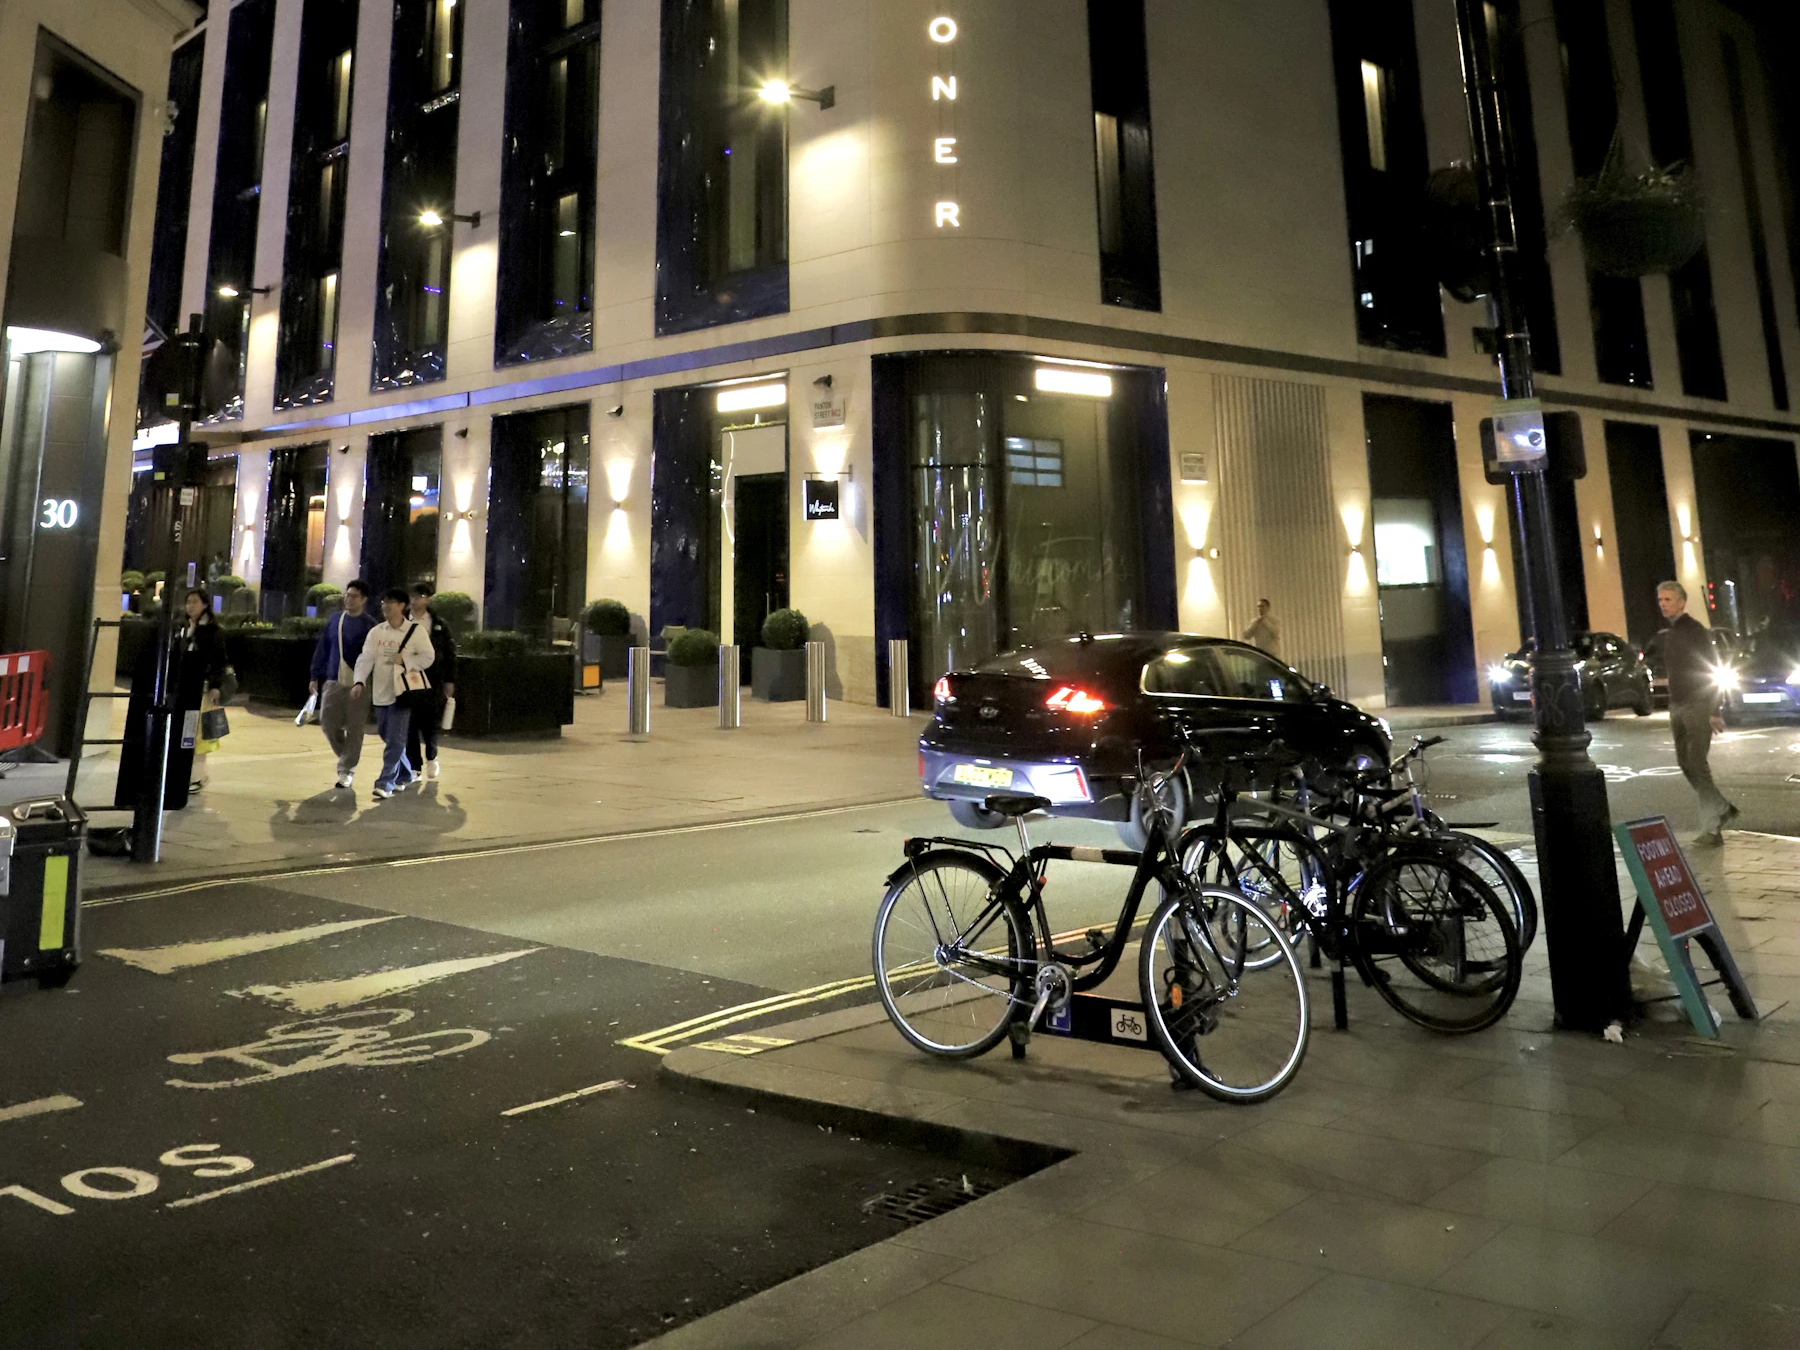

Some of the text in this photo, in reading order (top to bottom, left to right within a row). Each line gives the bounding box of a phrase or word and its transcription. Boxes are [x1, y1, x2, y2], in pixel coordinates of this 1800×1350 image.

[814, 400, 832, 410] PANTON
[814, 410, 830, 420] STREET
[40, 498, 78, 528] 30
[1636, 838, 1675, 861] FOOTWAY
[1654, 865, 1682, 889] AHEAD
[1663, 892, 1697, 918] CLOSED
